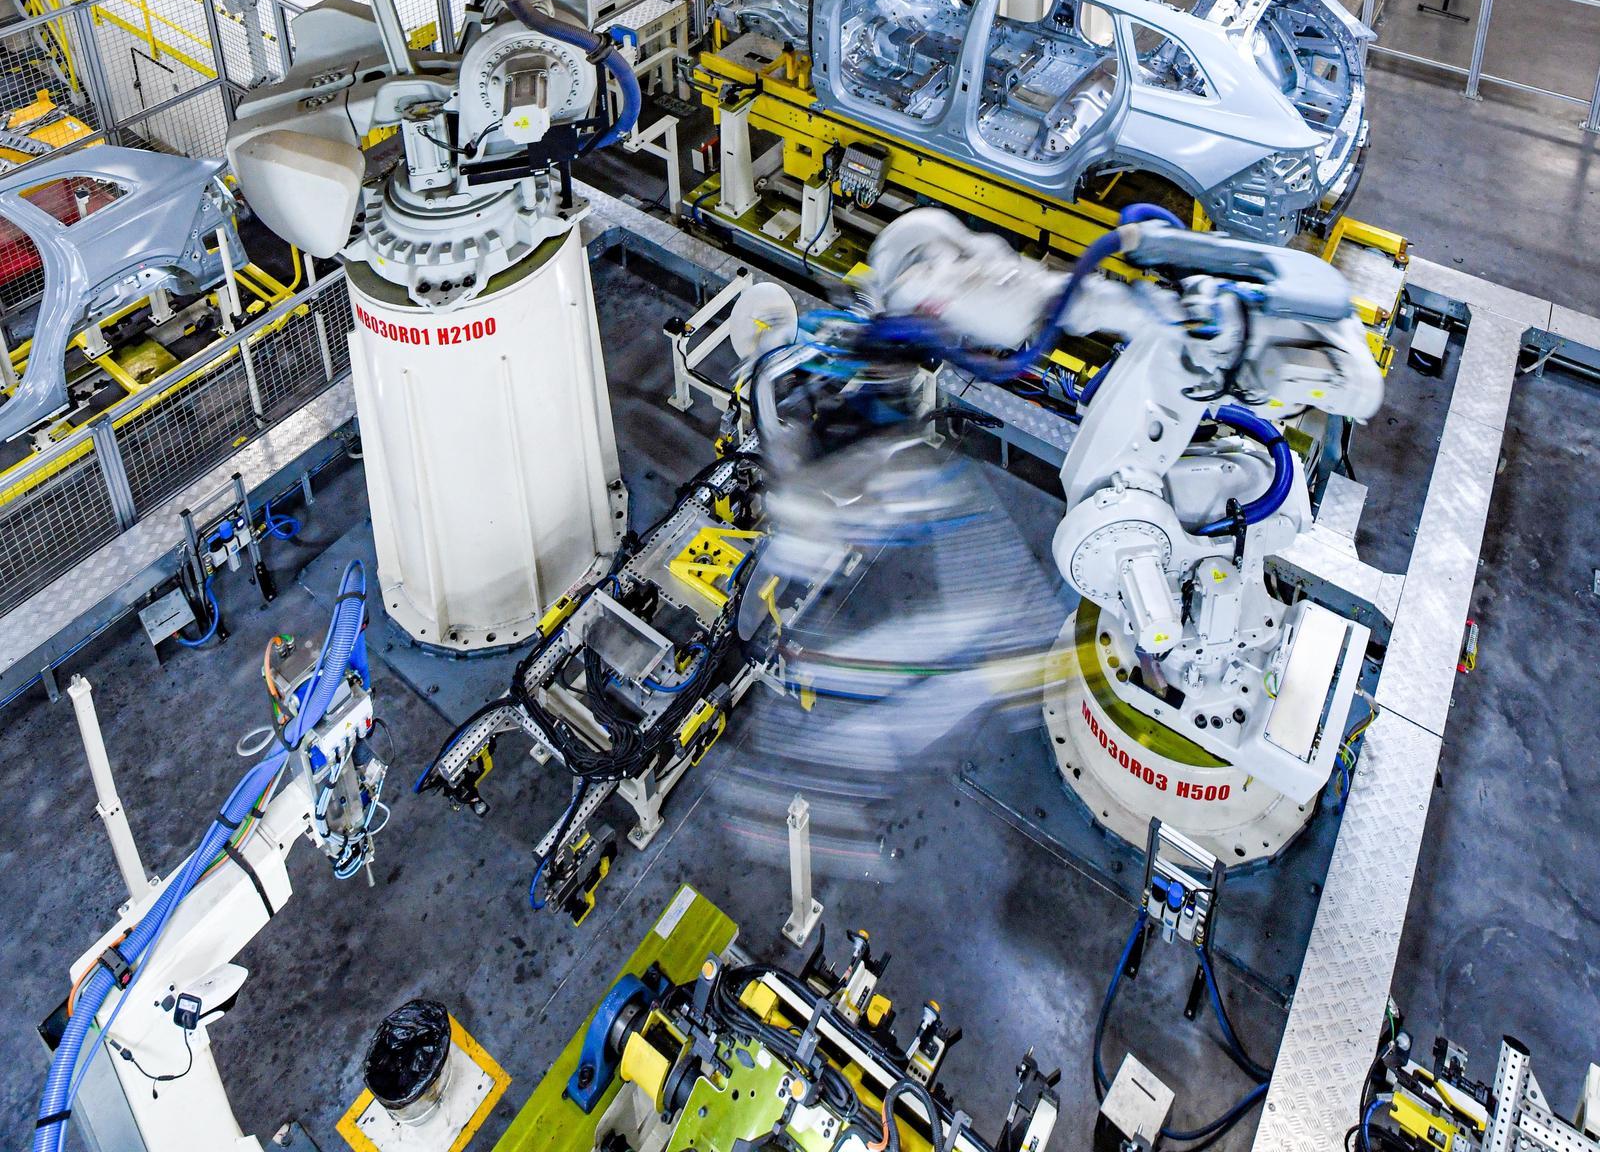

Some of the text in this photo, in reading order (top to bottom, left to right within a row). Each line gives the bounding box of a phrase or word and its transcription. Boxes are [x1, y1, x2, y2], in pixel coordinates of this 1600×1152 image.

[355, 303, 496, 346] MB030R01 H2100
[1081, 699, 1231, 801] MB030R03 H500
